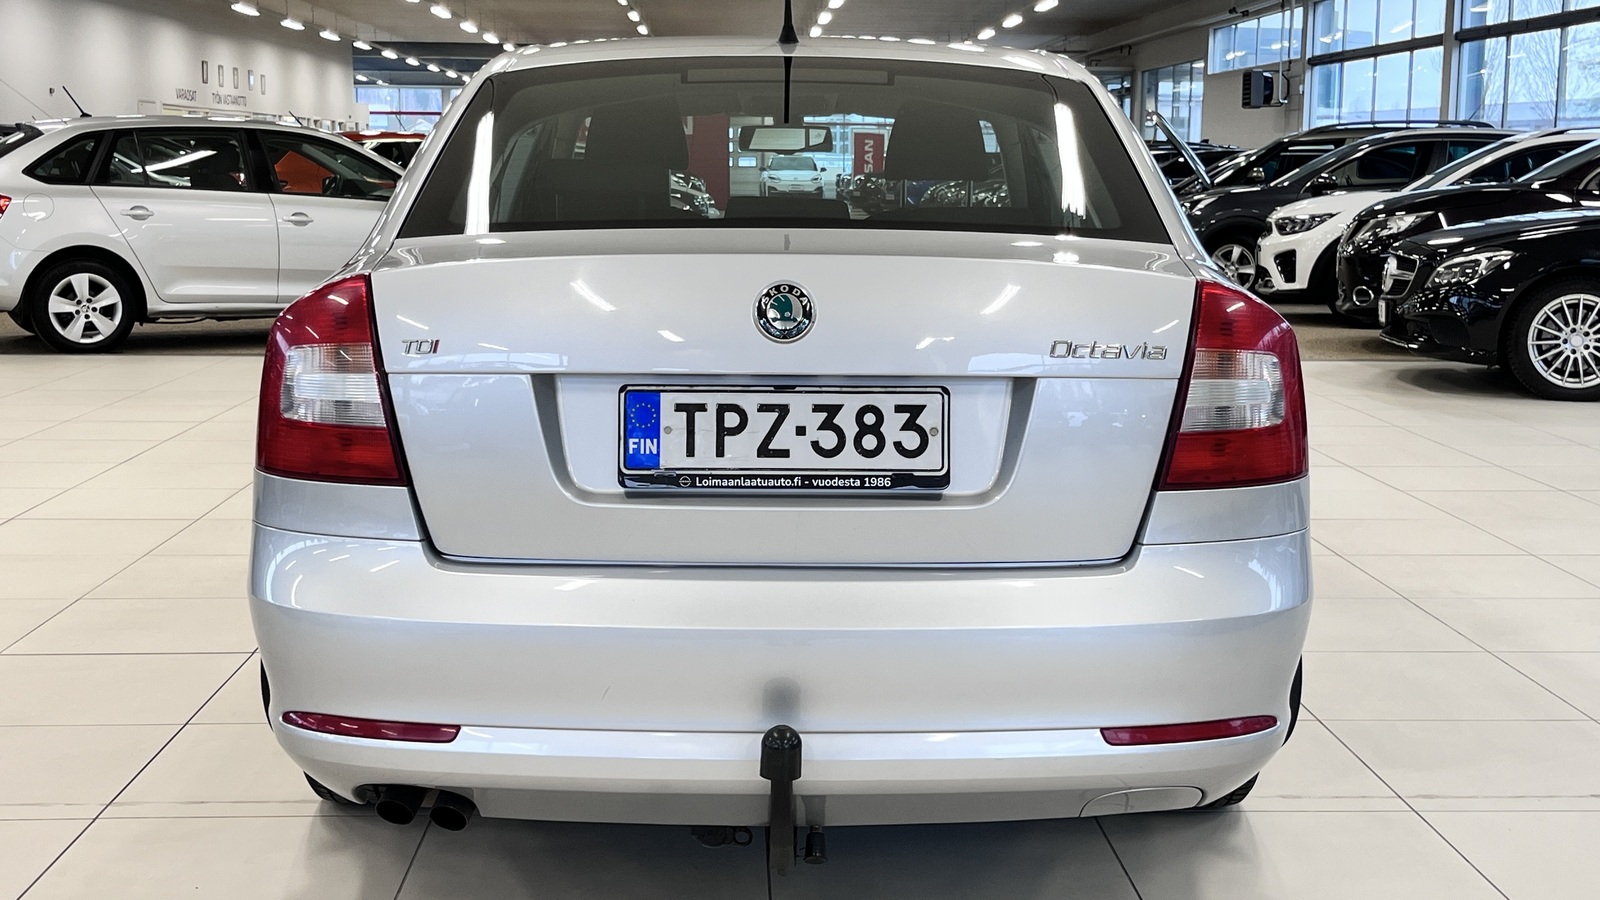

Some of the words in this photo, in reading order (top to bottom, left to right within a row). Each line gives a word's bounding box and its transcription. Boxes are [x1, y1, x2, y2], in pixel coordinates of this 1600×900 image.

[401, 339, 440, 354] TDI
[1049, 340, 1168, 360] Octavia
[628, 438, 658, 455] FIN
[695, 476, 802, 487] Loimaanlaatuauto.fi
[812, 476, 861, 487] vuodesta
[864, 477, 892, 487] 1986
